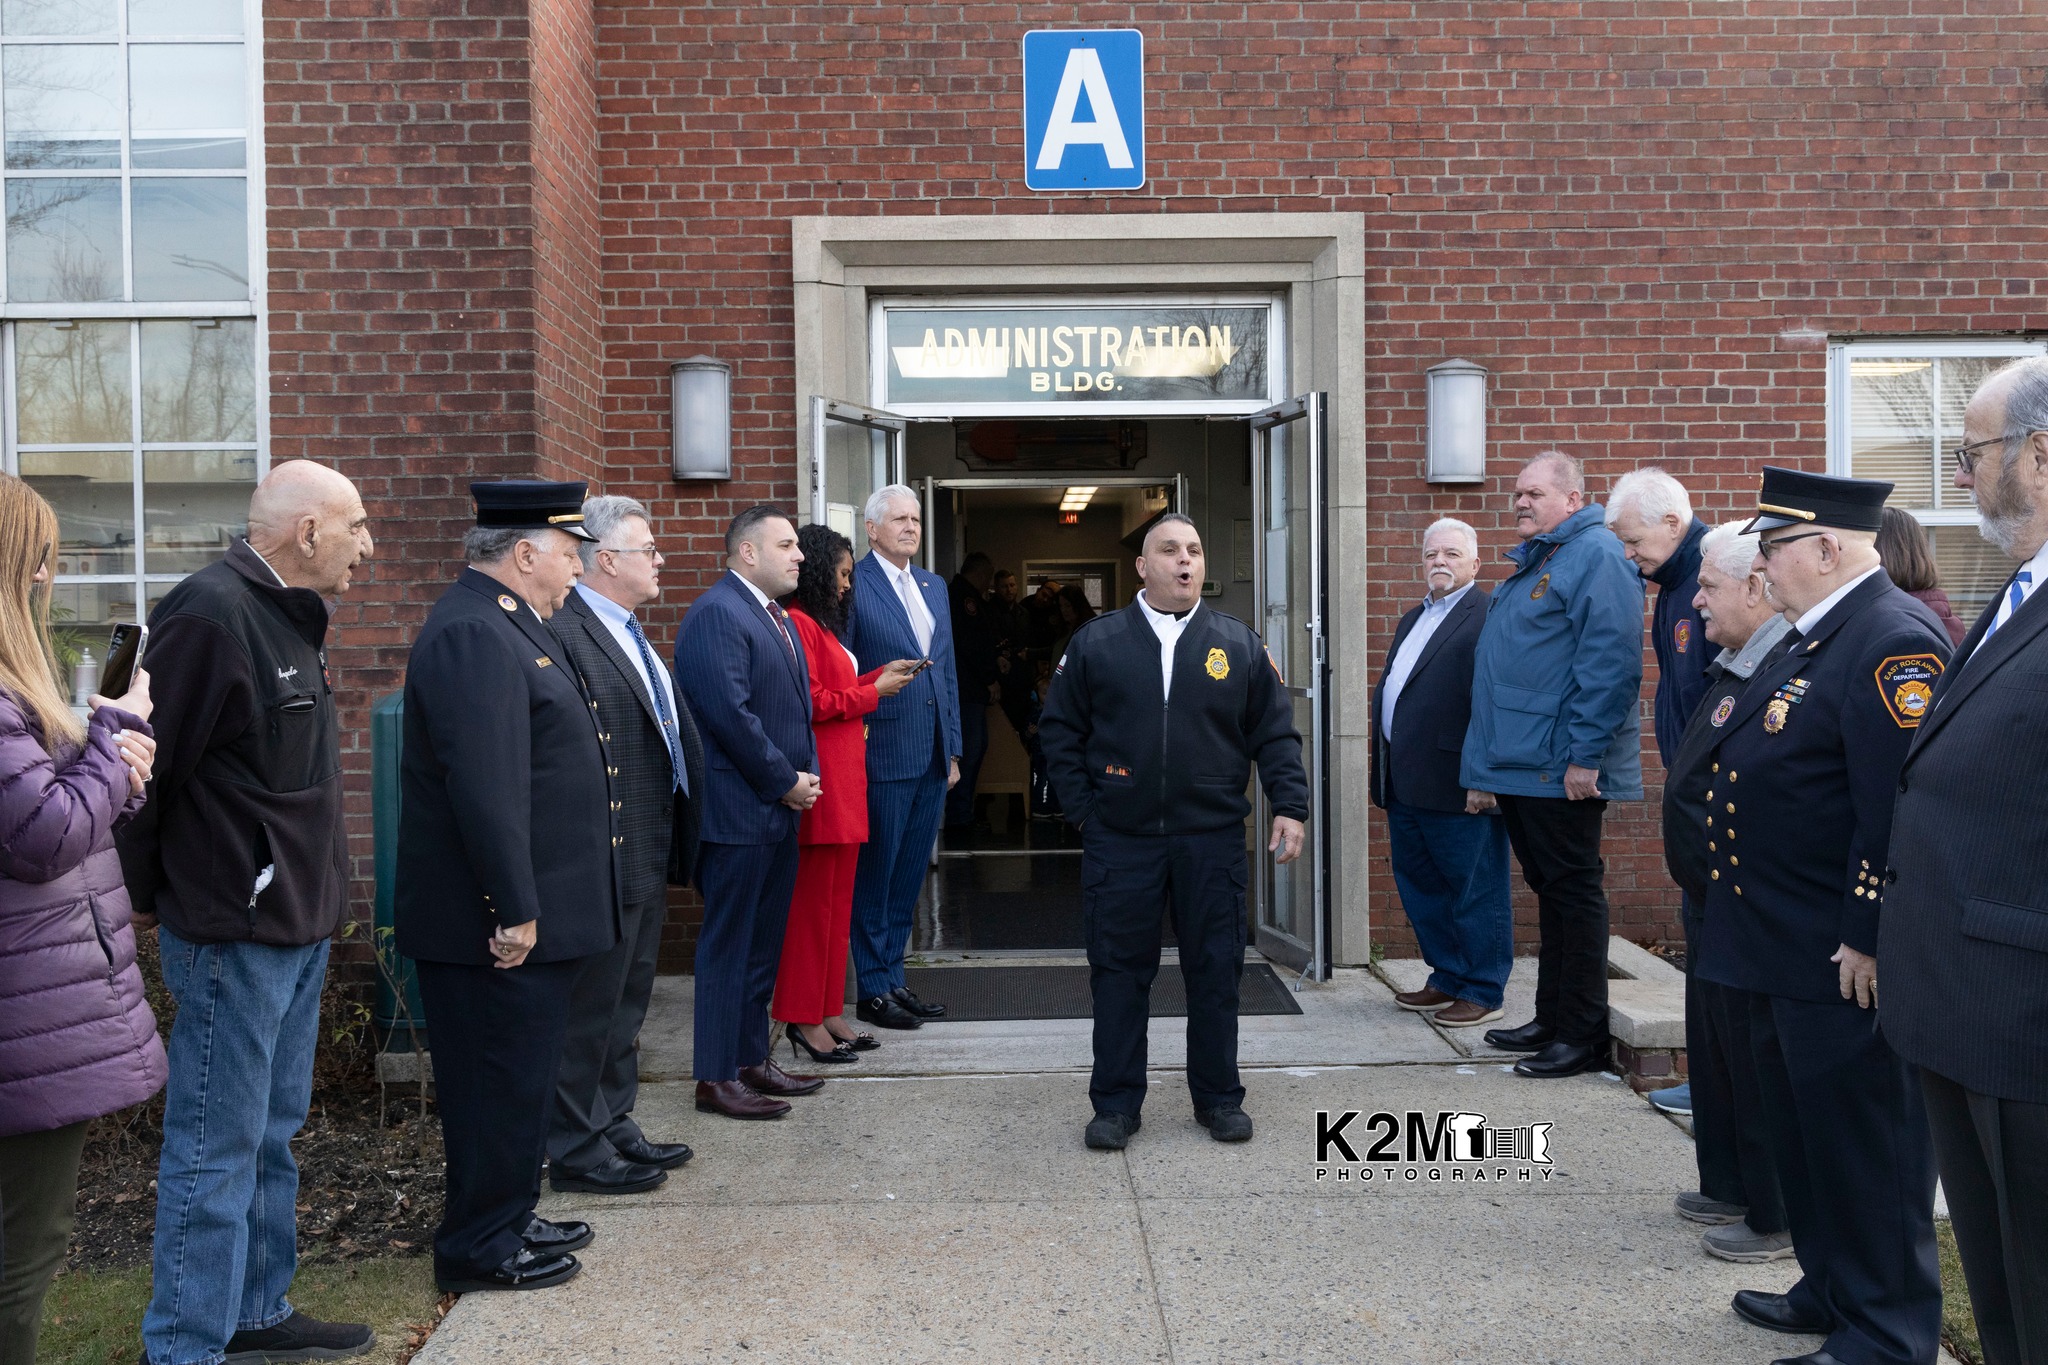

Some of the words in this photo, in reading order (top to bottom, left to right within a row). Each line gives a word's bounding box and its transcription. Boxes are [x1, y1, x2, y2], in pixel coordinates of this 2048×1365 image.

[1035, 48, 1135, 170] A
[921, 326, 1231, 367] ADMINISTRATION
[1031, 371, 1123, 392] BLDG.
[1884, 665, 1899, 680] EAST
[1900, 660, 1938, 675] ROCKAWAY
[1893, 673, 1931, 681] DEPARTMENT
